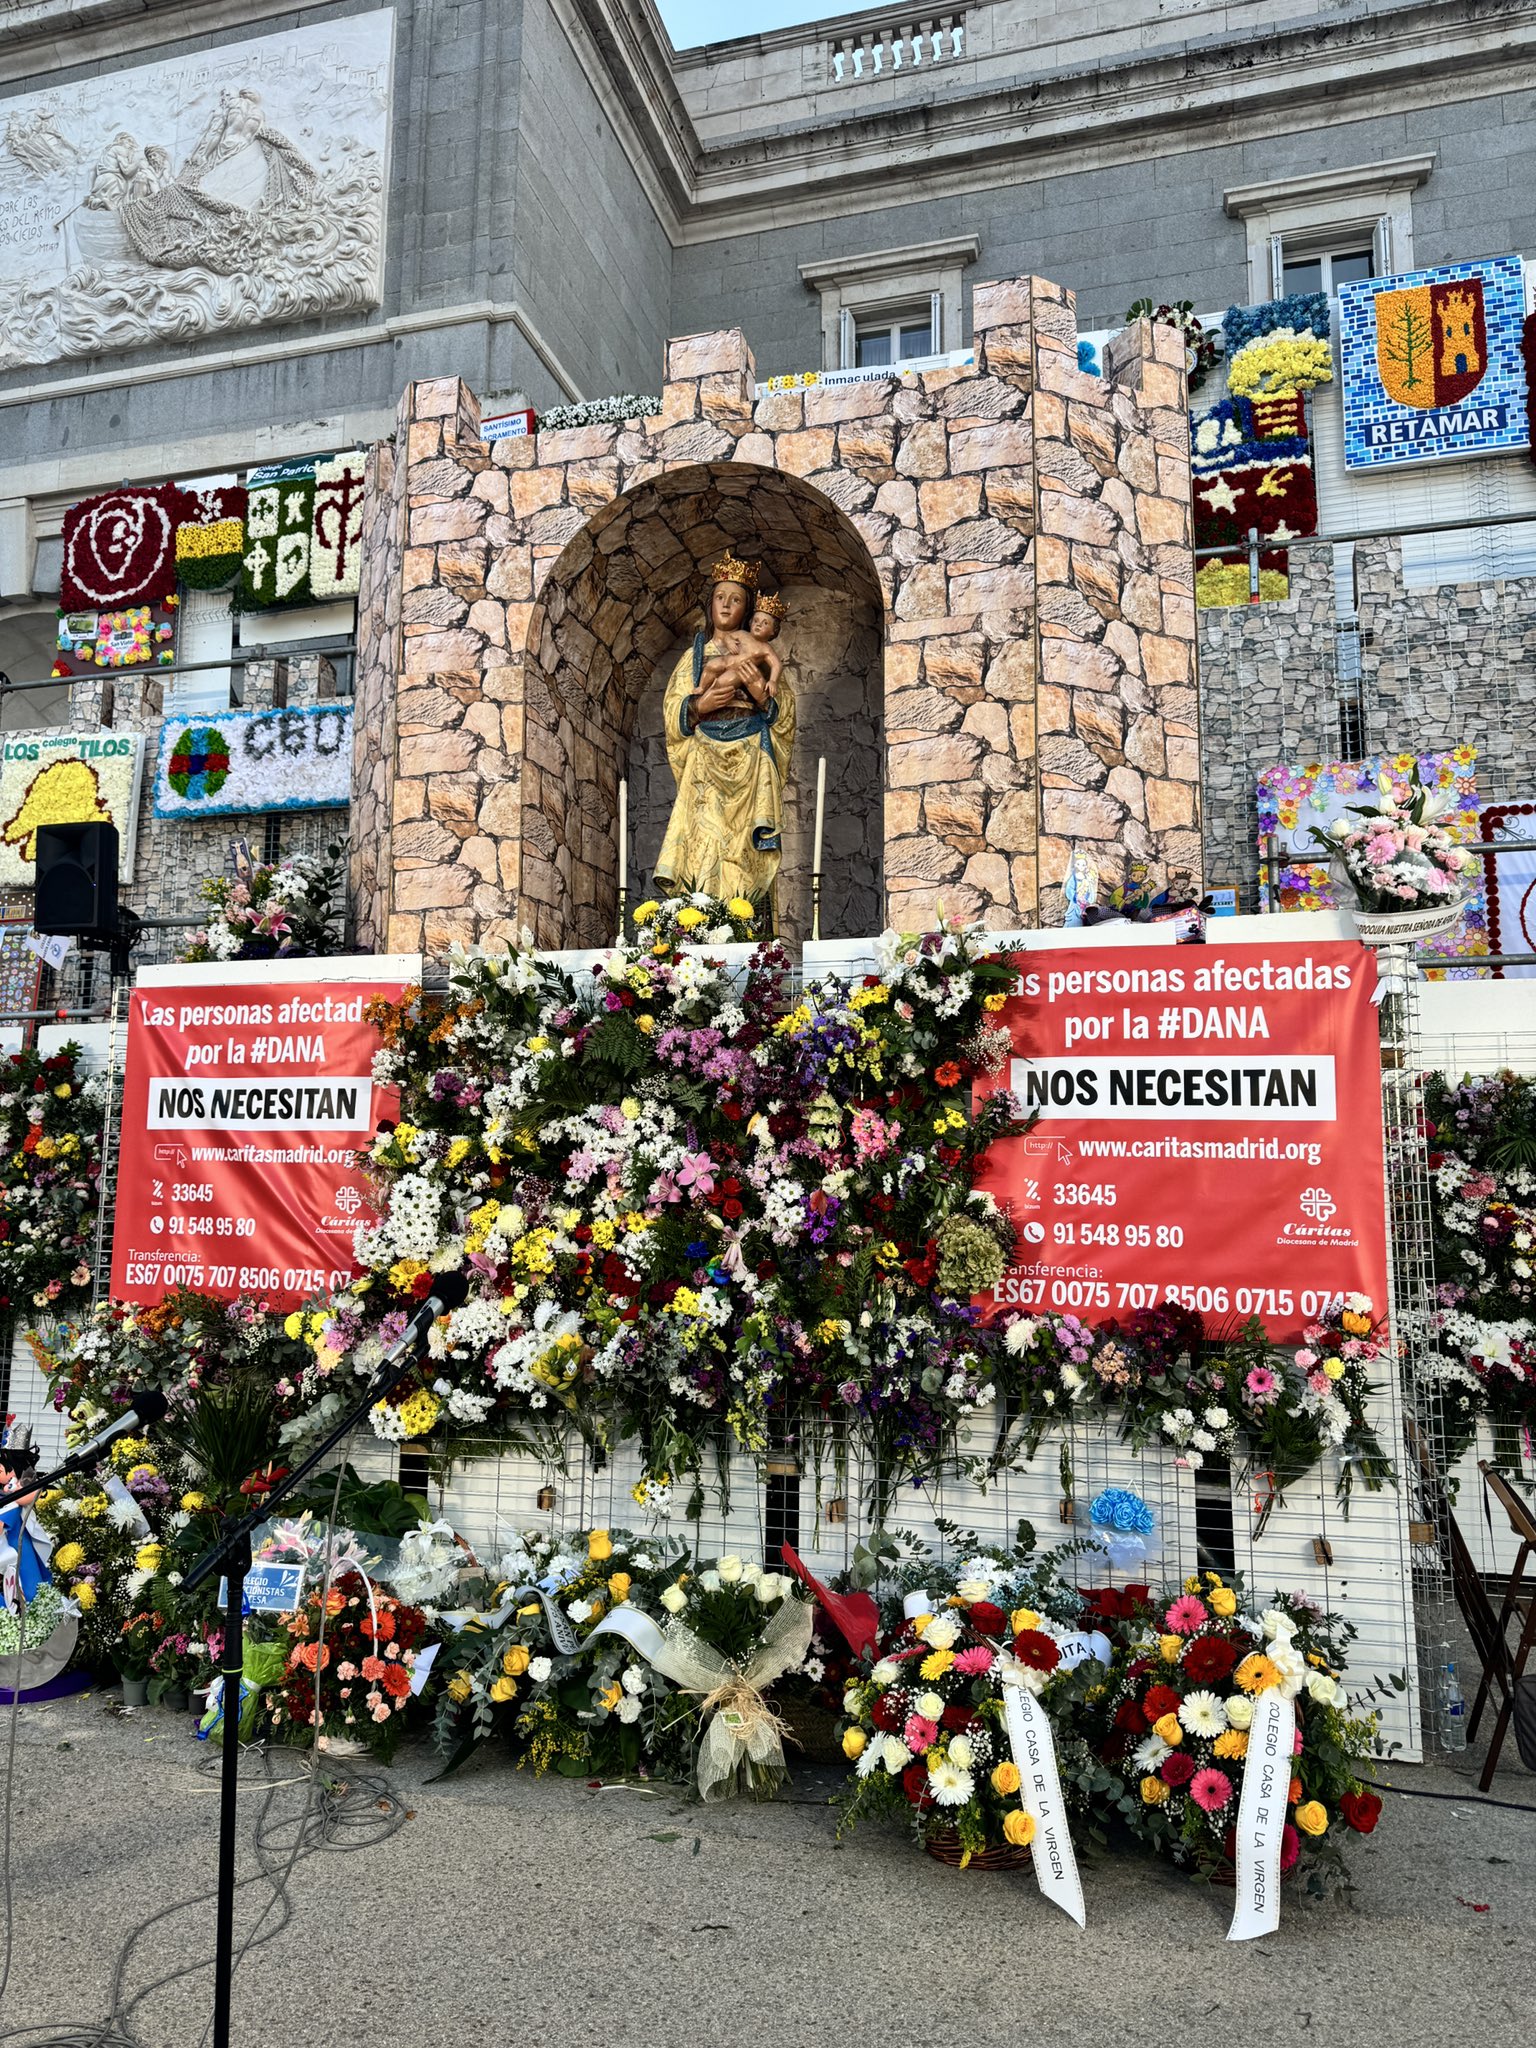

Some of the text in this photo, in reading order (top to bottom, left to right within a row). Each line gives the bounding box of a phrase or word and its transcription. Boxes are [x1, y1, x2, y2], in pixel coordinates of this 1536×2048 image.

[483, 418, 522, 432] SANTÍSIMO
[1371, 408, 1500, 445] RETAMAR
[252, 470, 279, 480] San
[4, 737, 131, 761] LOS colegio TILOS
[1385, 922, 1412, 935] NUESTRA
[1009, 958, 1352, 1003] as personas afectadas
[140, 996, 368, 1033] Las personas afectad
[1064, 1005, 1270, 1048] por la #DANA
[184, 1035, 326, 1071] por la #DANA
[1026, 1068, 1317, 1107] NOS NECESITAN
[158, 1087, 358, 1120] NOS NECESITAN
[191, 1144, 356, 1169] www.caritasmadrid.org
[1078, 1137, 1322, 1166] www.caritasmadrid.org
[171, 1183, 213, 1203] 33645
[1053, 1183, 1117, 1207] 33645
[168, 1216, 256, 1237] 91 548 95 80
[320, 1215, 372, 1228] Cáritas
[1283, 1221, 1352, 1238] Cáritas
[1053, 1222, 1184, 1248] 91 548 95 80
[1276, 1237, 1360, 1248] Diocesana de Madrid
[127, 1248, 201, 1263] Transferencia:
[125, 1263, 161, 1285] ES67
[163, 1265, 204, 1286] 0075
[208, 1265, 235, 1288] 707
[239, 1267, 280, 1290] 8506
[283, 1268, 325, 1291] 0715
[993, 1278, 1043, 1306] ES67
[1051, 1280, 1109, 1307] 0075
[1115, 1282, 1158, 1310] 707
[1165, 1285, 1229, 1313] 8506
[1235, 1287, 1293, 1316] 0715
[243, 1576, 269, 1586] OLEGIO
[244, 1585, 285, 1597] CIONISTAS
[1025, 1729, 1040, 1766] CASA
[1033, 1775, 1046, 1793] DE
[1039, 1801, 1050, 1818] LA
[1254, 1702, 1280, 1914] COLEGIO CASA DE LA VIRGEN
[1044, 1827, 1065, 1881] VIRGEN
